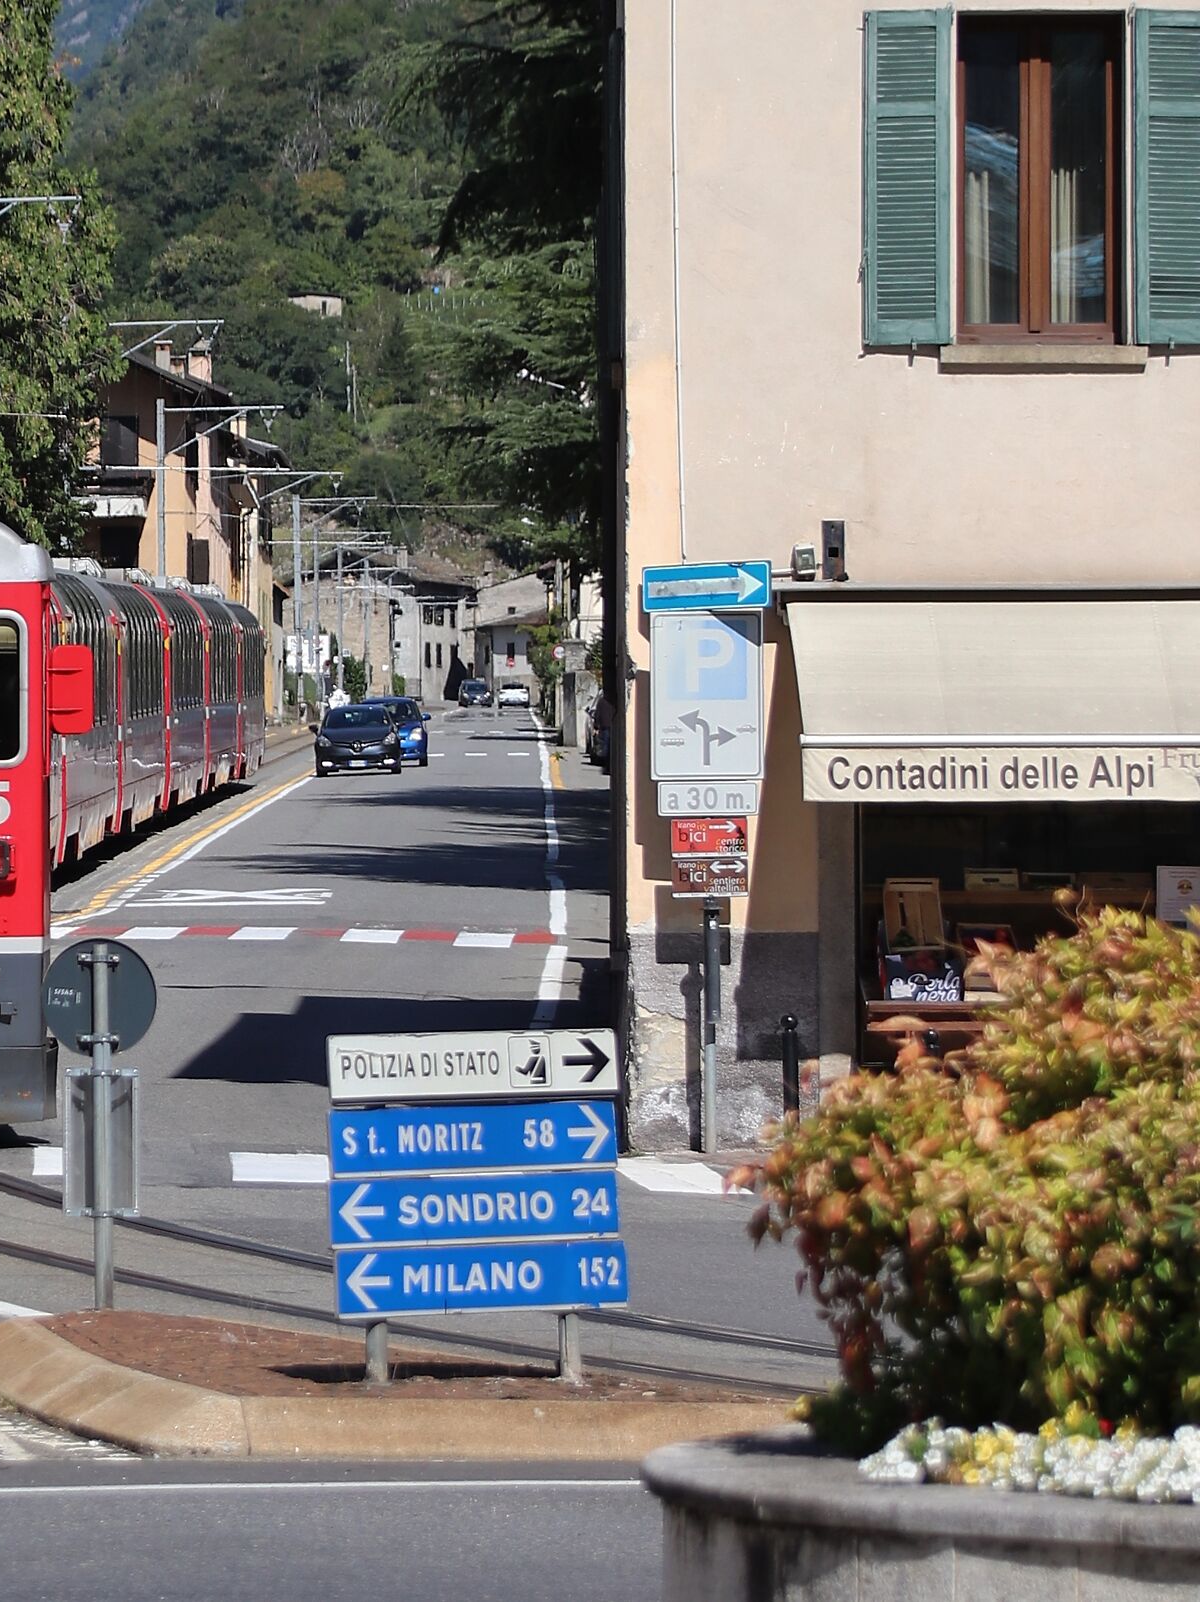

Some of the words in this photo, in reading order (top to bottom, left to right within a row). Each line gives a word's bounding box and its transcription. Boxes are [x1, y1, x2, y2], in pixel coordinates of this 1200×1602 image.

[685, 628, 735, 693] P
[827, 756, 988, 790] Contadini
[1000, 756, 1079, 789] delle
[1088, 755, 1154, 796] Alpi
[667, 793, 679, 809] a
[687, 787, 718, 809] 30
[726, 792, 751, 809] m.
[679, 828, 707, 842] bici
[679, 868, 707, 882] bici
[704, 884, 745, 892] valtellina
[709, 877, 745, 885] sentiero
[916, 989, 960, 1001] nera
[341, 1053, 416, 1080] POLIZIA
[421, 1052, 438, 1077] DI
[445, 1050, 500, 1076] STATO
[398, 1122, 483, 1153] MORITZ
[523, 1118, 554, 1148] 58
[397, 1190, 554, 1225] SONDRIO
[571, 1188, 611, 1217] 24
[403, 1260, 542, 1294] MILANO
[578, 1256, 620, 1287] 152
